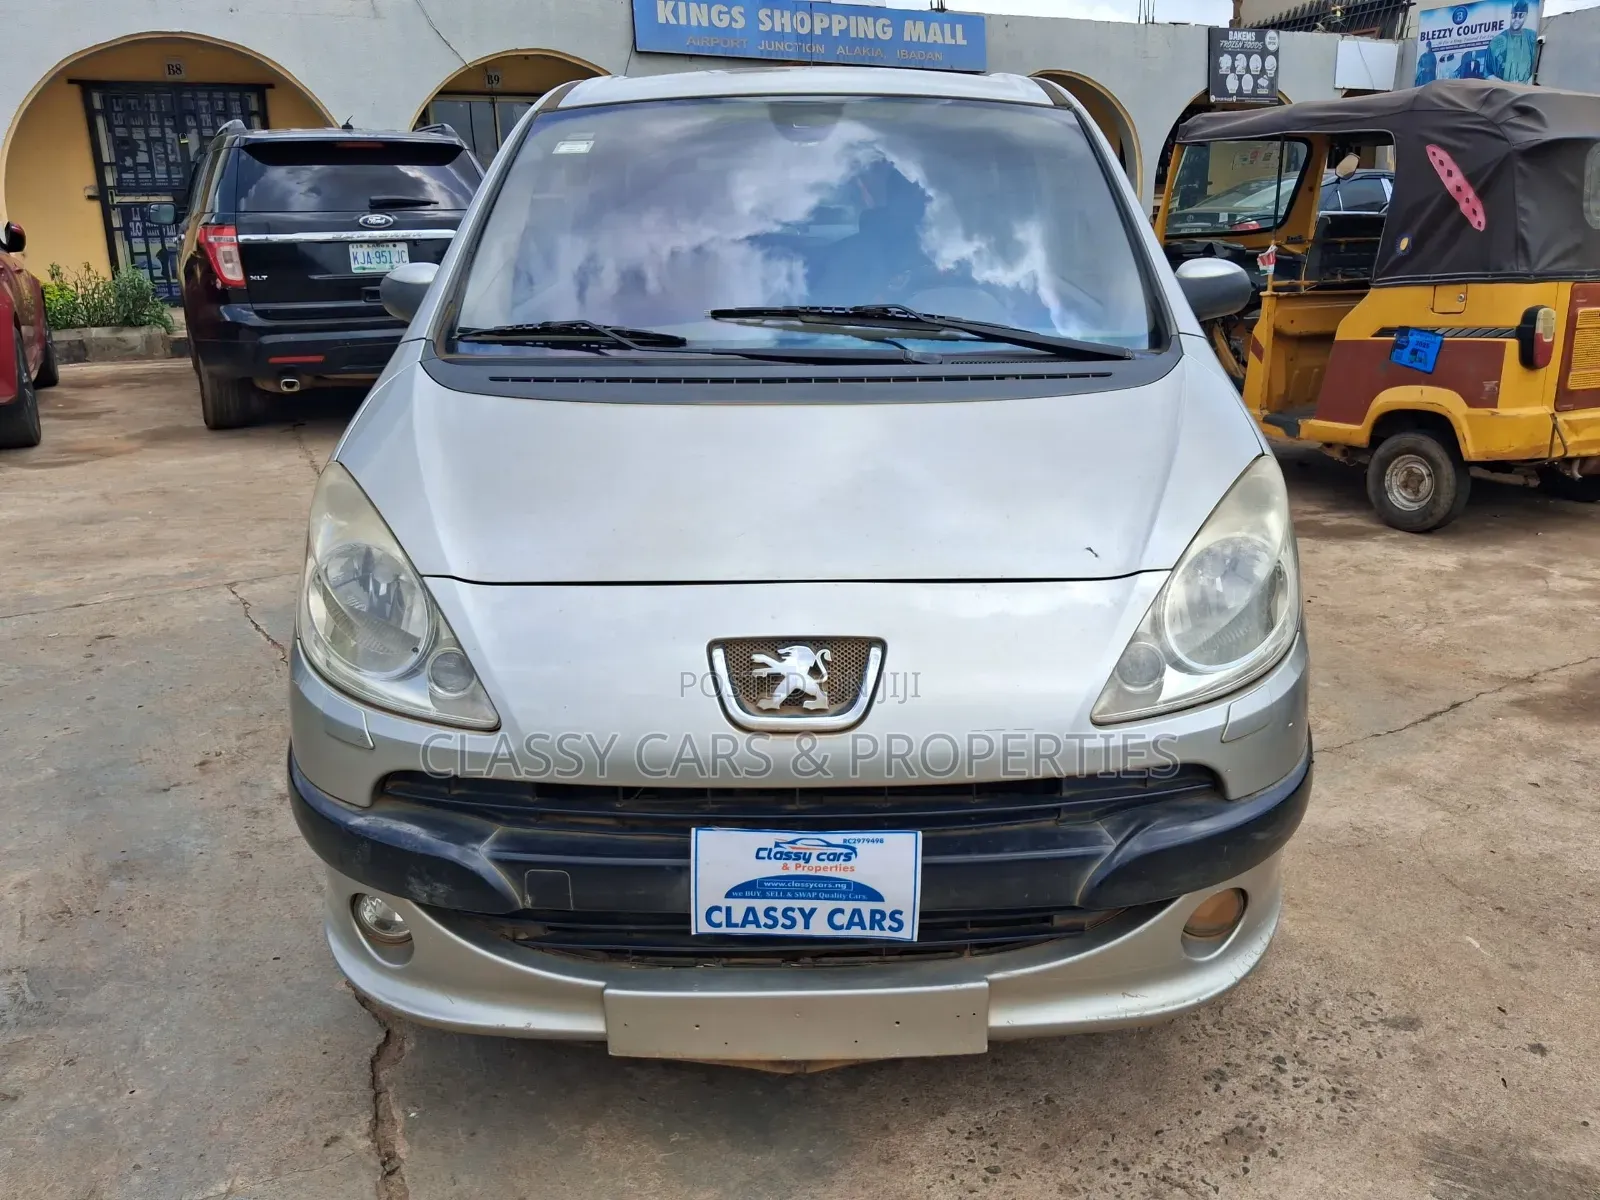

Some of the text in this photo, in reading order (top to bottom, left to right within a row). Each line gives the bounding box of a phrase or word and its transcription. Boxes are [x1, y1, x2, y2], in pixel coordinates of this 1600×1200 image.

[656, 0, 968, 45] KINGS SHOPPING MALL
[1420, 28, 1454, 41] BLEZZY
[1456, 20, 1505, 36] COUTURE
[686, 36, 748, 48] AIRPORT
[758, 41, 825, 54] JUNCTION
[896, 49, 943, 61] IBADAN
[1220, 40, 1243, 48] FROZEN
[1243, 41, 1264, 49] FOODS
[167, 63, 183, 75] B8
[487, 74, 500, 85] B9
[755, 847, 853, 863] Classy cars
[782, 863, 855, 873] & Properties
[763, 881, 847, 889] www.classycars.ng
[819, 892, 847, 900] Quality
[705, 905, 904, 932] CLASSY CARS
